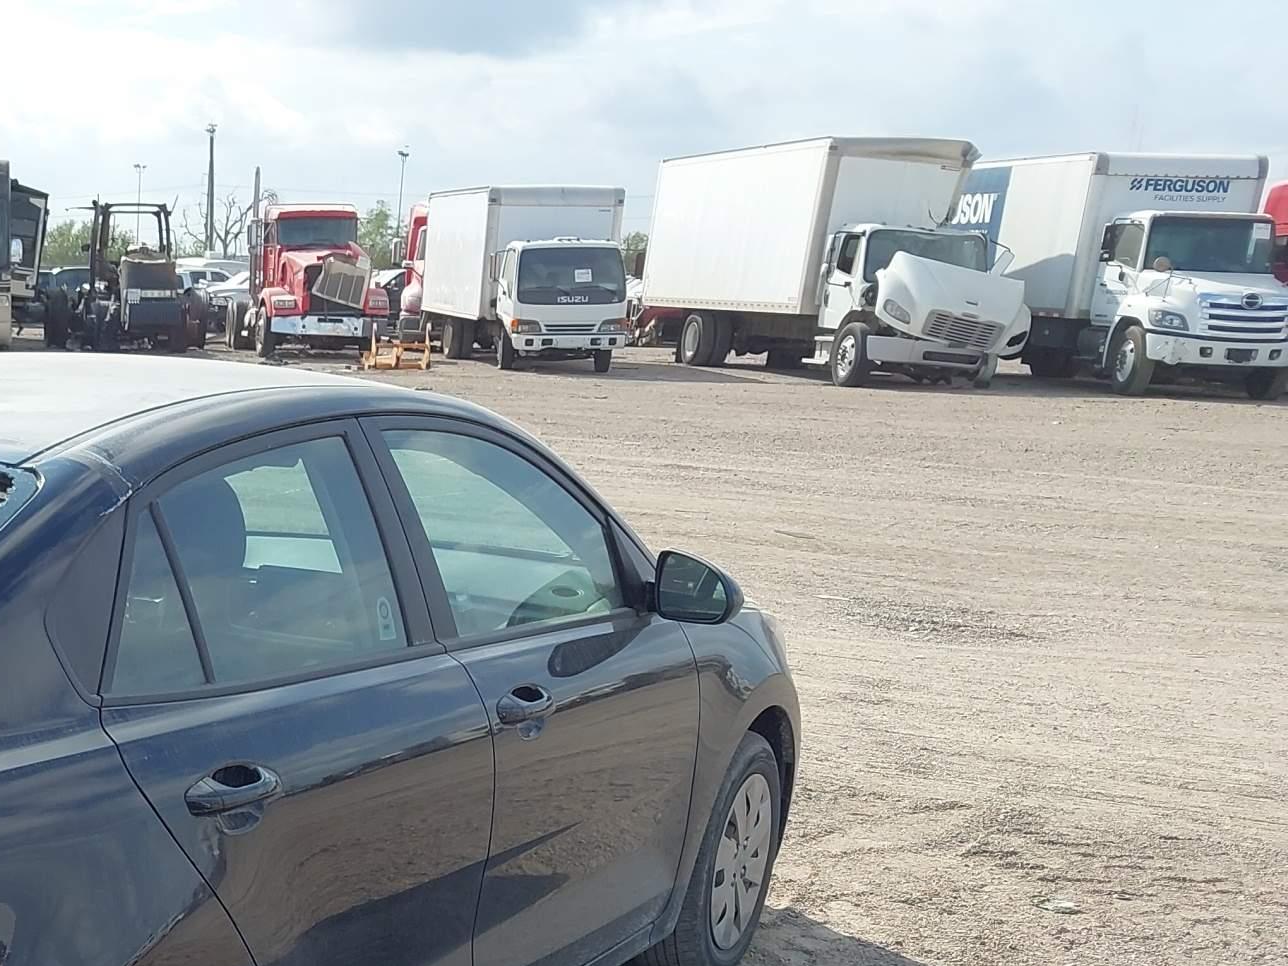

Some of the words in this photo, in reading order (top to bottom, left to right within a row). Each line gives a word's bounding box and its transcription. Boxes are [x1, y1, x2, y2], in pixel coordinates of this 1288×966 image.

[1144, 179, 1230, 193] FERGUSON
[1154, 194, 1194, 202] FACILITIES
[1196, 194, 1226, 203] SUPPLY
[557, 295, 589, 303] ISUZU
